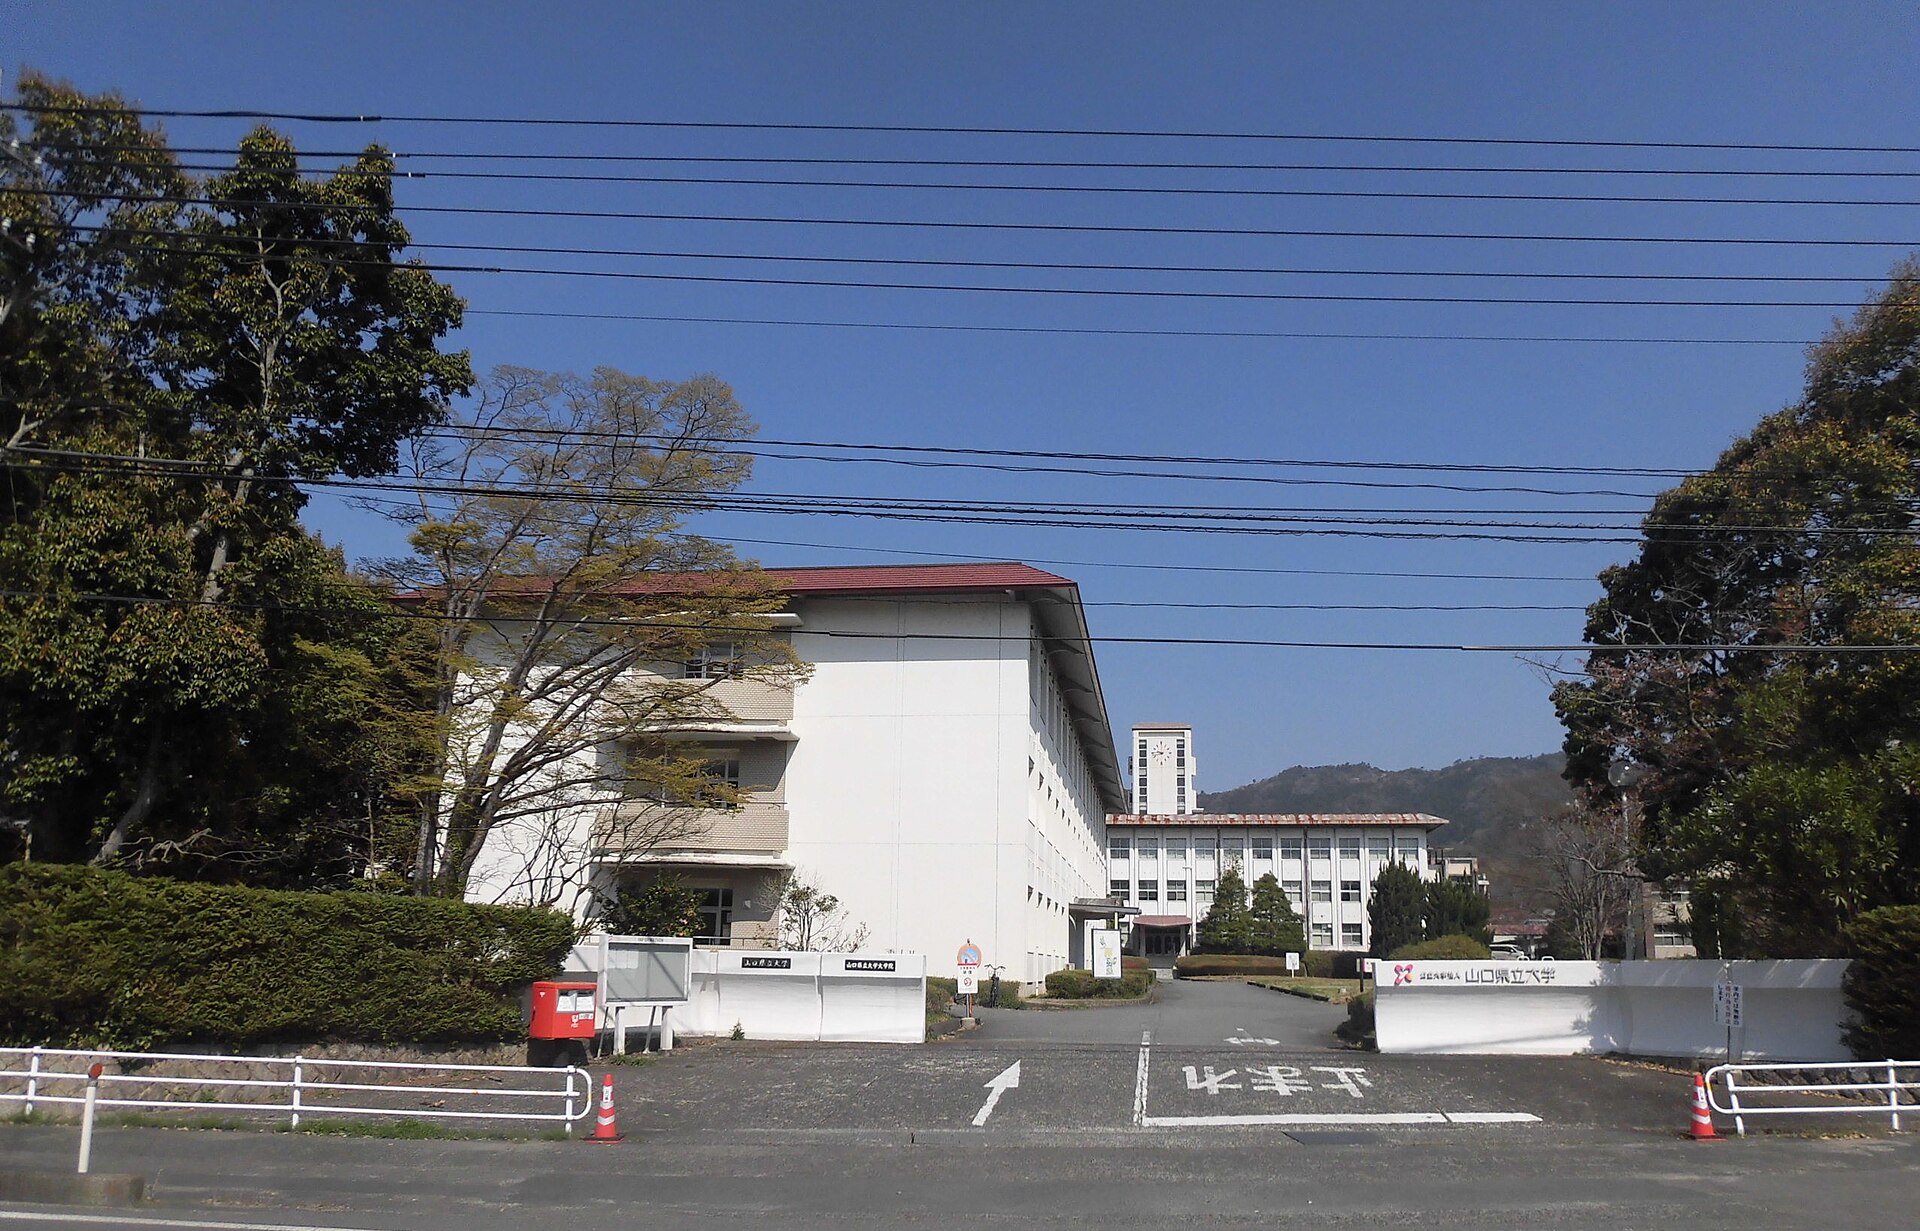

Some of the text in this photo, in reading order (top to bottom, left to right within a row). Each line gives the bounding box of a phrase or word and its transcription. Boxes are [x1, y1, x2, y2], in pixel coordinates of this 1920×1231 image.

[744, 957, 790, 969] 山口県立大学
[1465, 967, 1555, 984] 山口県立大学
[1182, 1065, 1373, 1098] 止まれ
